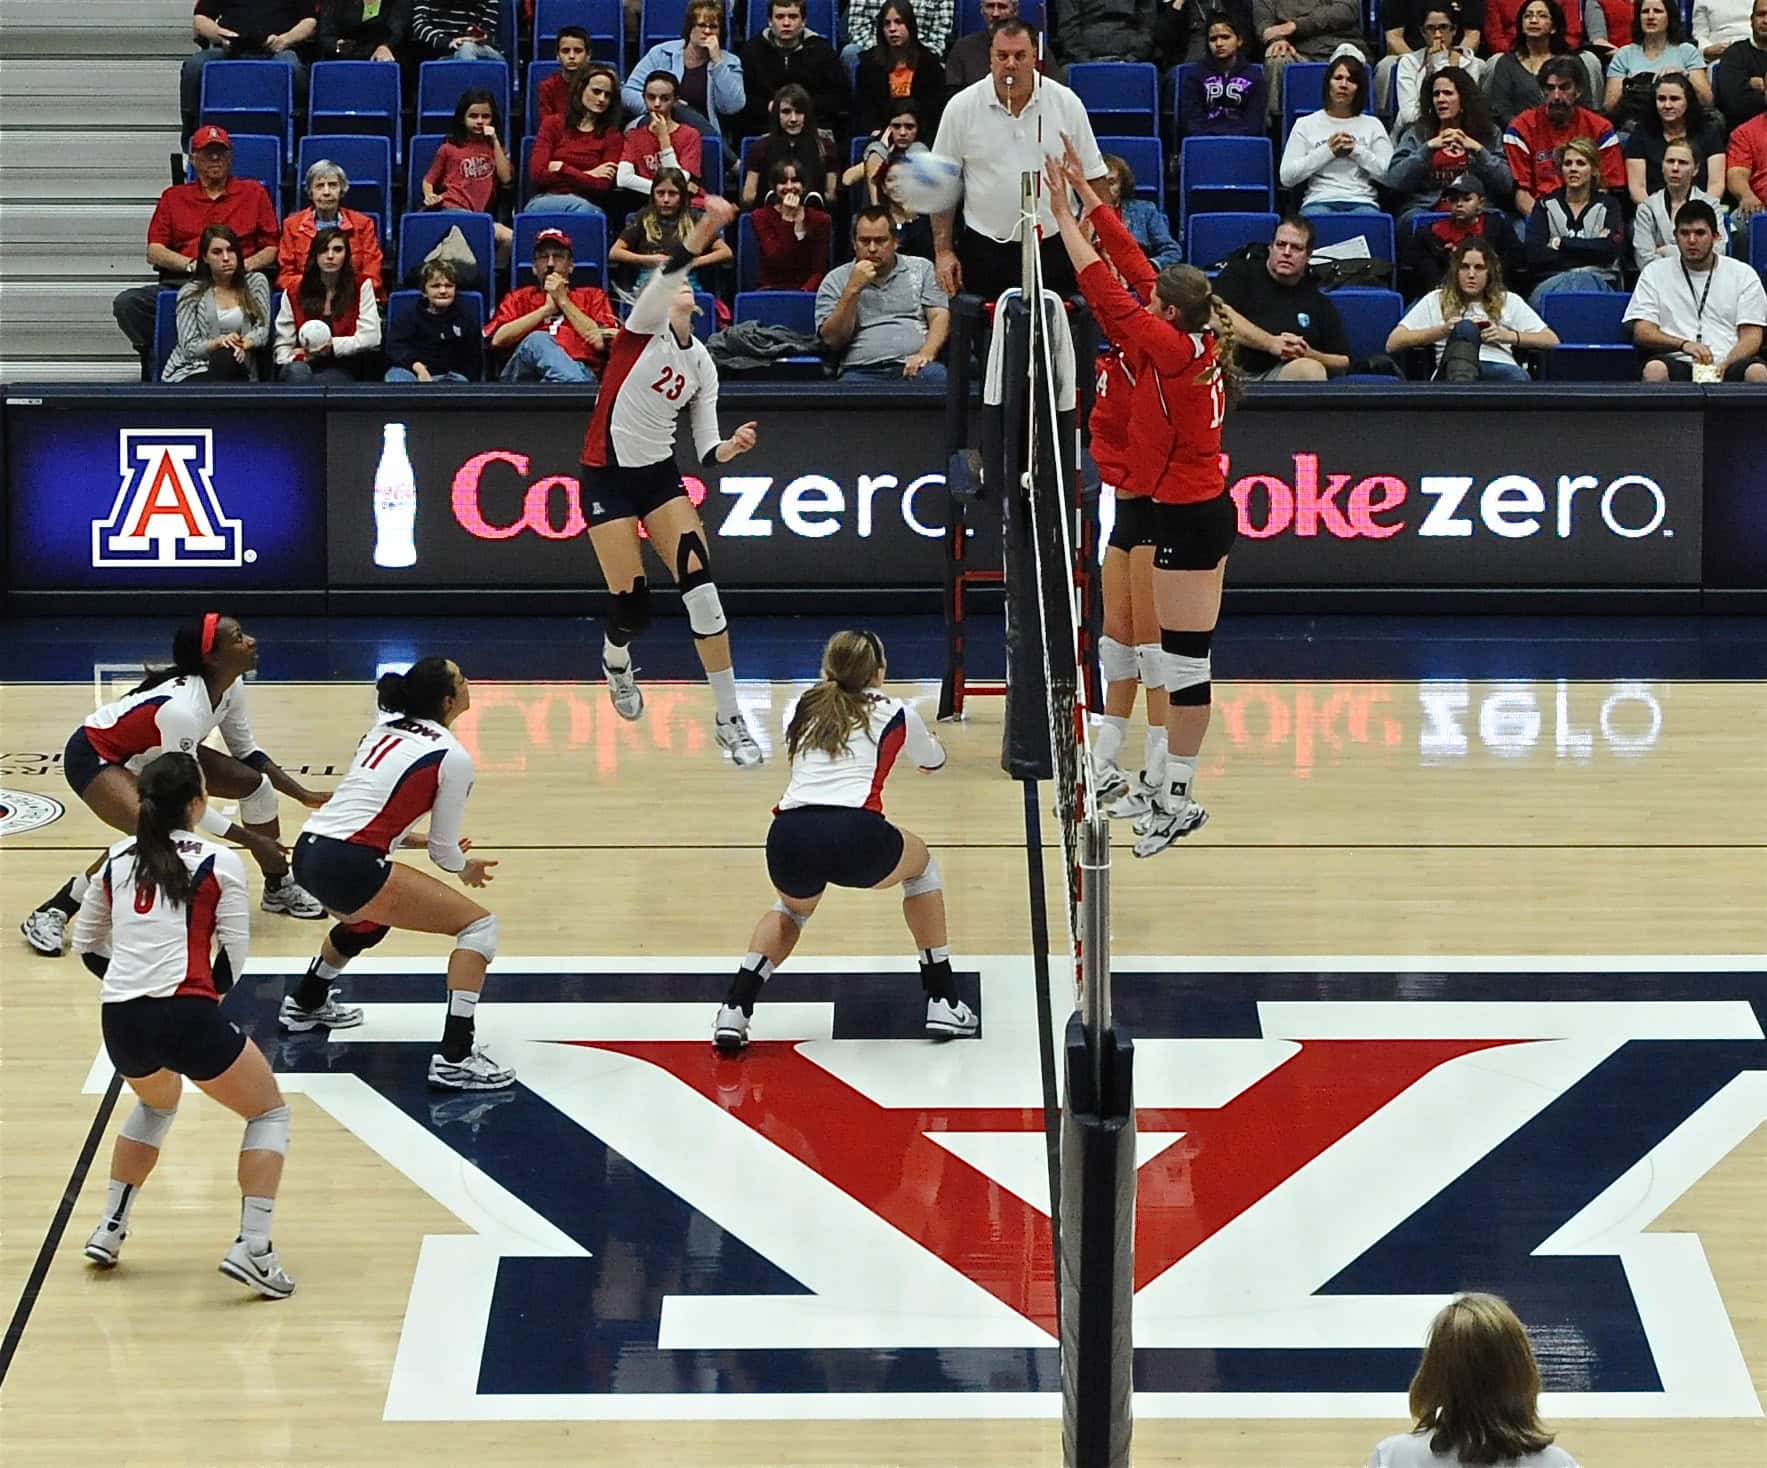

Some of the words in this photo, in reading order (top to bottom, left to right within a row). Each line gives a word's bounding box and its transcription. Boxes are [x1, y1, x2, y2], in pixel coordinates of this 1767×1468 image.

[650, 365, 686, 401] 23
[91, 428, 243, 568] A
[1221, 453, 1408, 539] oke
[361, 734, 403, 770] 11
